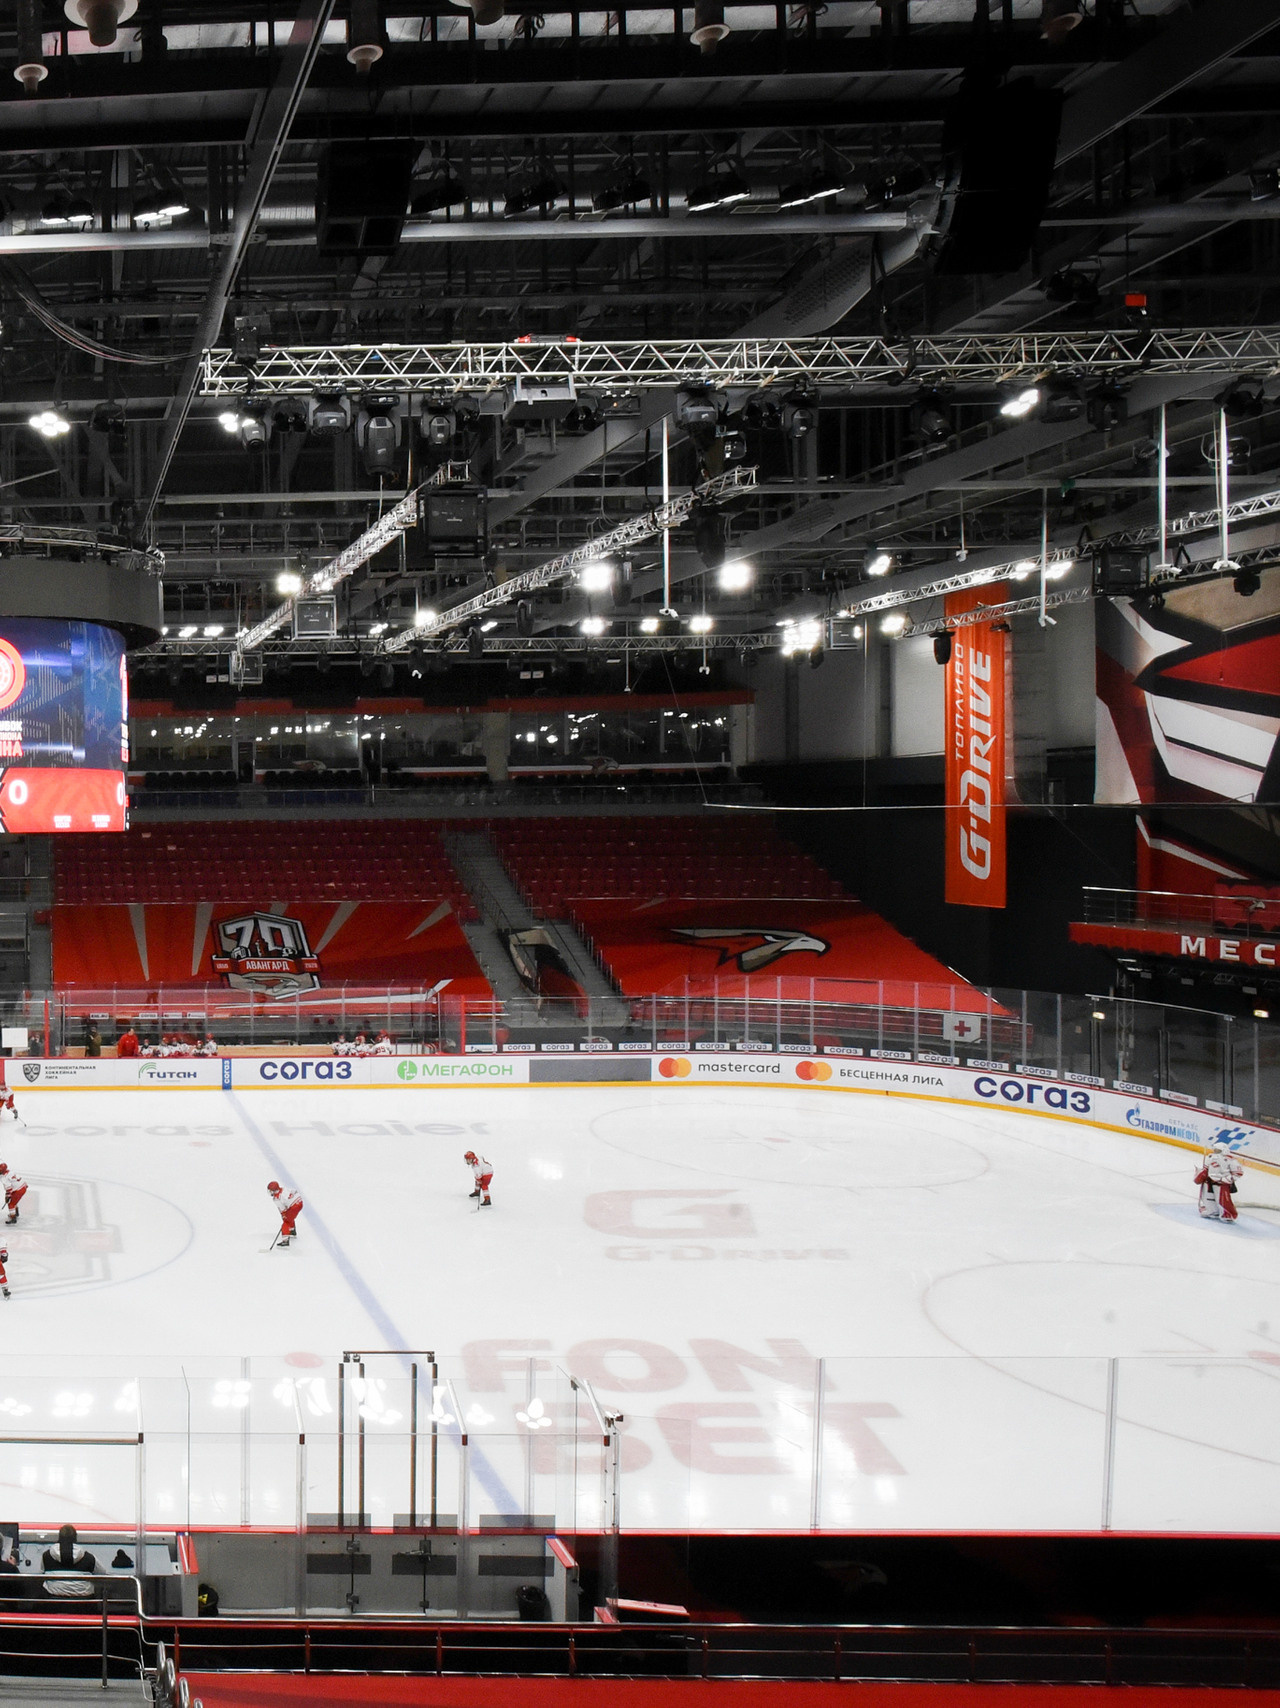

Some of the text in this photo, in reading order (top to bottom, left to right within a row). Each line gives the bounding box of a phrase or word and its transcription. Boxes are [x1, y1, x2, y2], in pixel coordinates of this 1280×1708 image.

[954, 642, 965, 760] ТОПЛИВО
[8, 779, 29, 805] 0
[246, 960, 290, 971] АВАНГАРД
[259, 1061, 353, 1080] согаз
[698, 1062, 781, 1074] mastercard
[839, 1068, 945, 1087] БЕСЦЕННАЯ ЛИГА
[973, 1076, 1092, 1114] согаз
[271, 1120, 492, 1137] Haier
[461, 1338, 839, 1393] FON
[513, 1402, 910, 1476] BET
